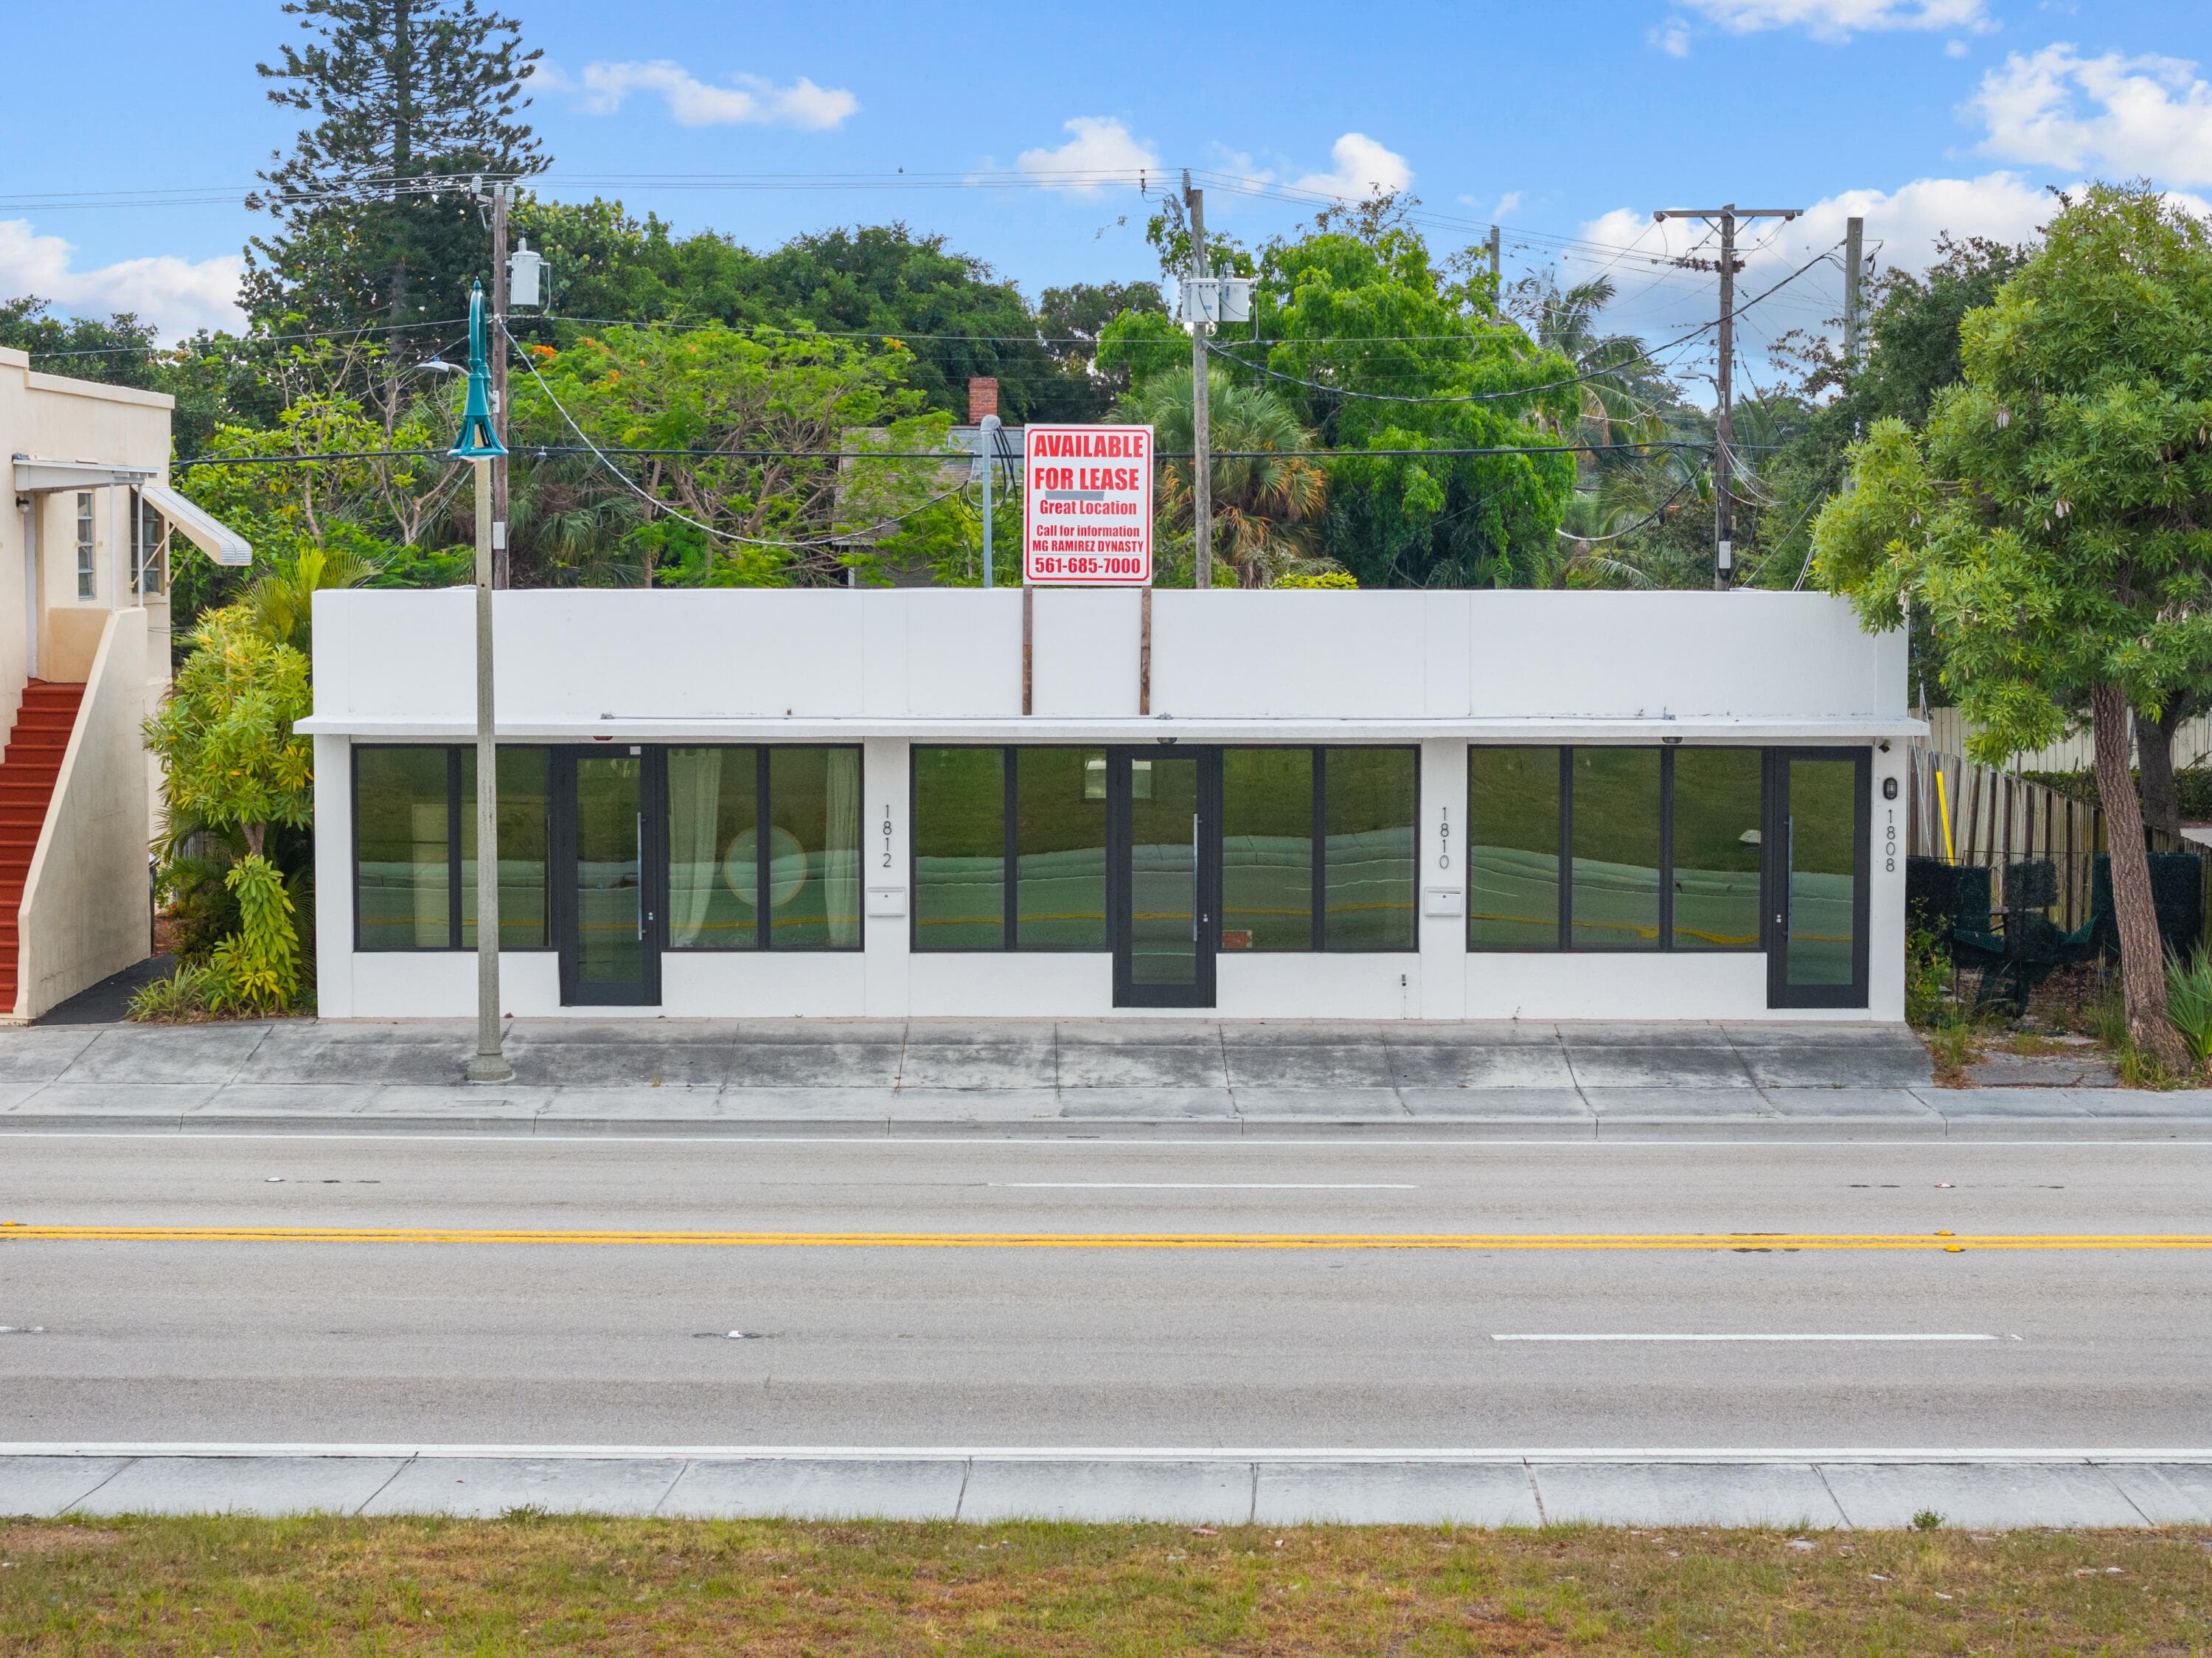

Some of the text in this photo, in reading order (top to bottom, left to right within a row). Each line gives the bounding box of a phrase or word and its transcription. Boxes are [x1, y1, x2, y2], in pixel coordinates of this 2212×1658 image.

[1034, 435, 1143, 457] AVAILABLE
[1034, 468, 1138, 490] FOR LEASE
[1040, 500, 1136, 515] Great Location
[1037, 525, 1139, 537] Call for information
[1032, 540, 1144, 552] MG RAMIREZ DYNASTY
[1035, 558, 1141, 573] 561-685-7000
[883, 804, 891, 867] 1812
[1439, 807, 1449, 869] 1810
[1886, 809, 1896, 872] 1808
